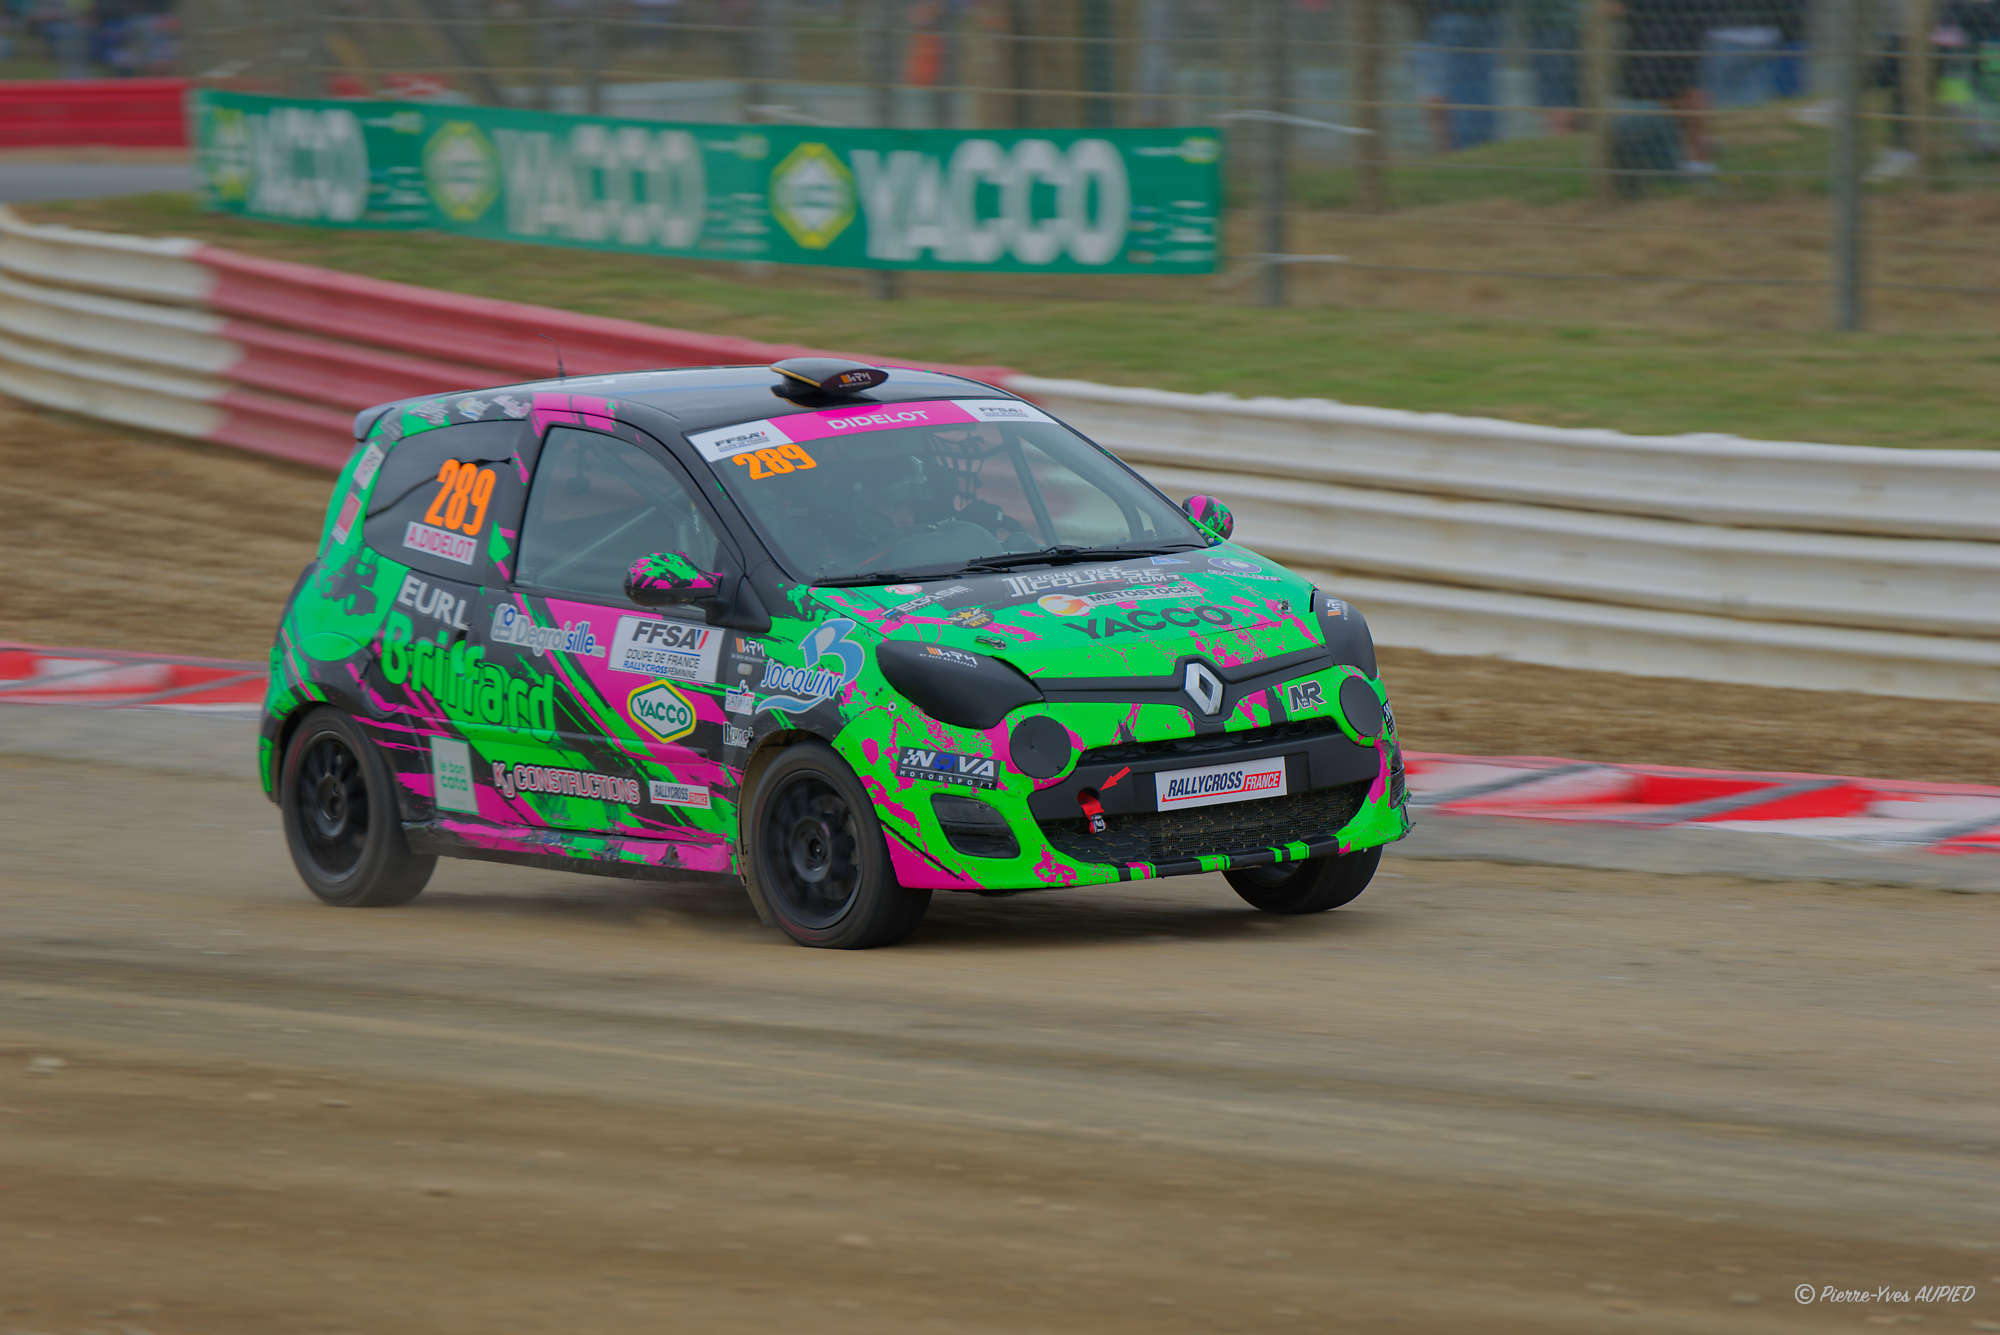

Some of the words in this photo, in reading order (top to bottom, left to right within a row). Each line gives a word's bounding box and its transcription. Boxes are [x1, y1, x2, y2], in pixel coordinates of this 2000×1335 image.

[849, 139, 1130, 265] YACCO
[827, 409, 930, 431] DIDELOT
[732, 444, 817, 480] 289
[424, 459, 496, 536] 289
[406, 525, 474, 559] A.DIDELOT
[398, 575, 471, 631] EURL
[632, 620, 697, 650] FFSA
[1062, 606, 1233, 640] YACCO
[625, 648, 654, 664] COUPE
[654, 652, 665, 664] DE
[667, 654, 700, 670] FRANCE
[760, 658, 842, 699] JOCQUIN
[637, 697, 688, 727] YACCO
[513, 764, 641, 805] CONSTRUCTIONS
[1168, 771, 1243, 797] RALLYCROSS
[1244, 772, 1281, 791] FRANCE
